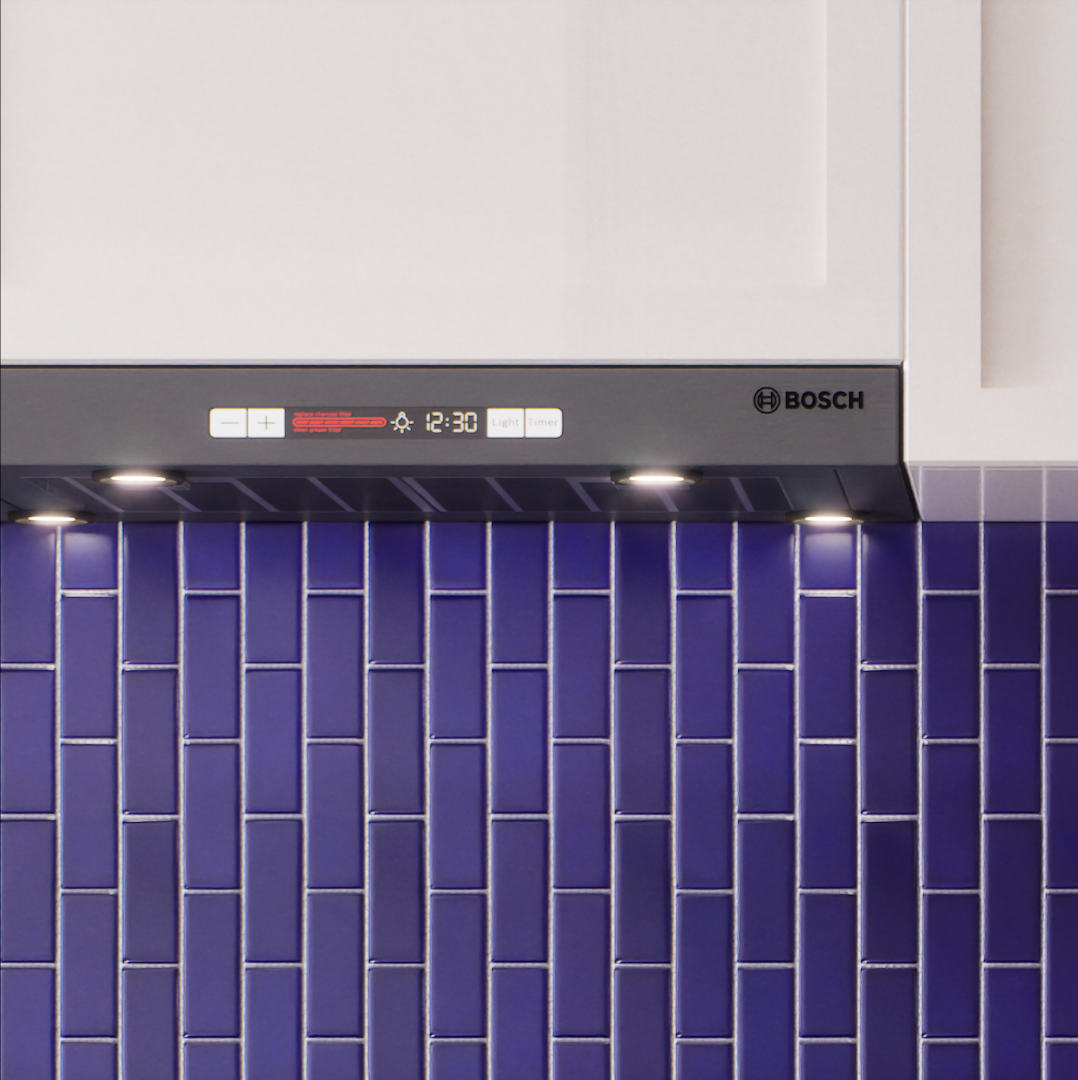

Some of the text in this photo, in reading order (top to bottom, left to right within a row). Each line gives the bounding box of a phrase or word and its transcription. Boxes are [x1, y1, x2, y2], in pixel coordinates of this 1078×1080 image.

[785, 391, 864, 410] BOSCH
[426, 412, 478, 433] 12:30
[492, 418, 519, 428] Light
[528, 418, 559, 427] Timer
